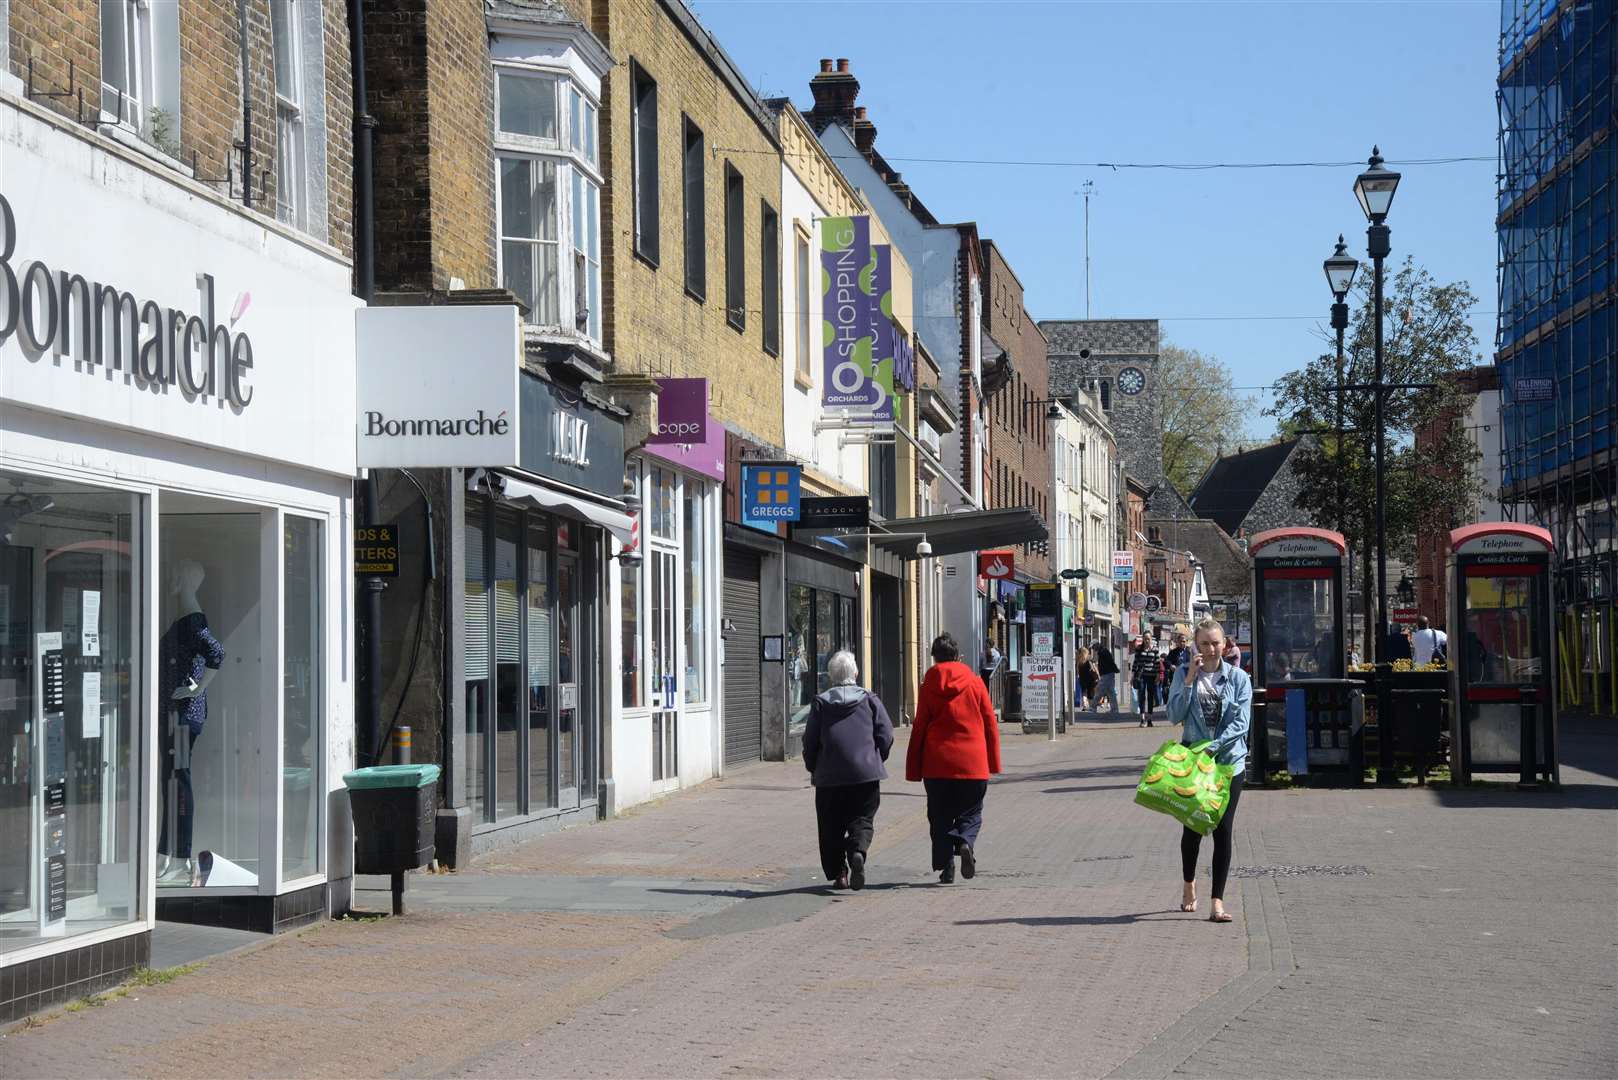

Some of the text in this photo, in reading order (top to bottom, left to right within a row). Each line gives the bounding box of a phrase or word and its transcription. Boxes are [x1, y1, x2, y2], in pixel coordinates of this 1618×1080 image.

[836, 229, 857, 356] SHOPPING
[365, 410, 508, 436] Bonmarché
[658, 423, 700, 437] cope
[752, 506, 794, 517] GREGGS
[380, 528, 390, 540] &
[1279, 543, 1318, 553] Telephone
[1480, 539, 1522, 549] Telephone
[1273, 559, 1293, 567] Coins
[1302, 559, 1322, 567] Cards
